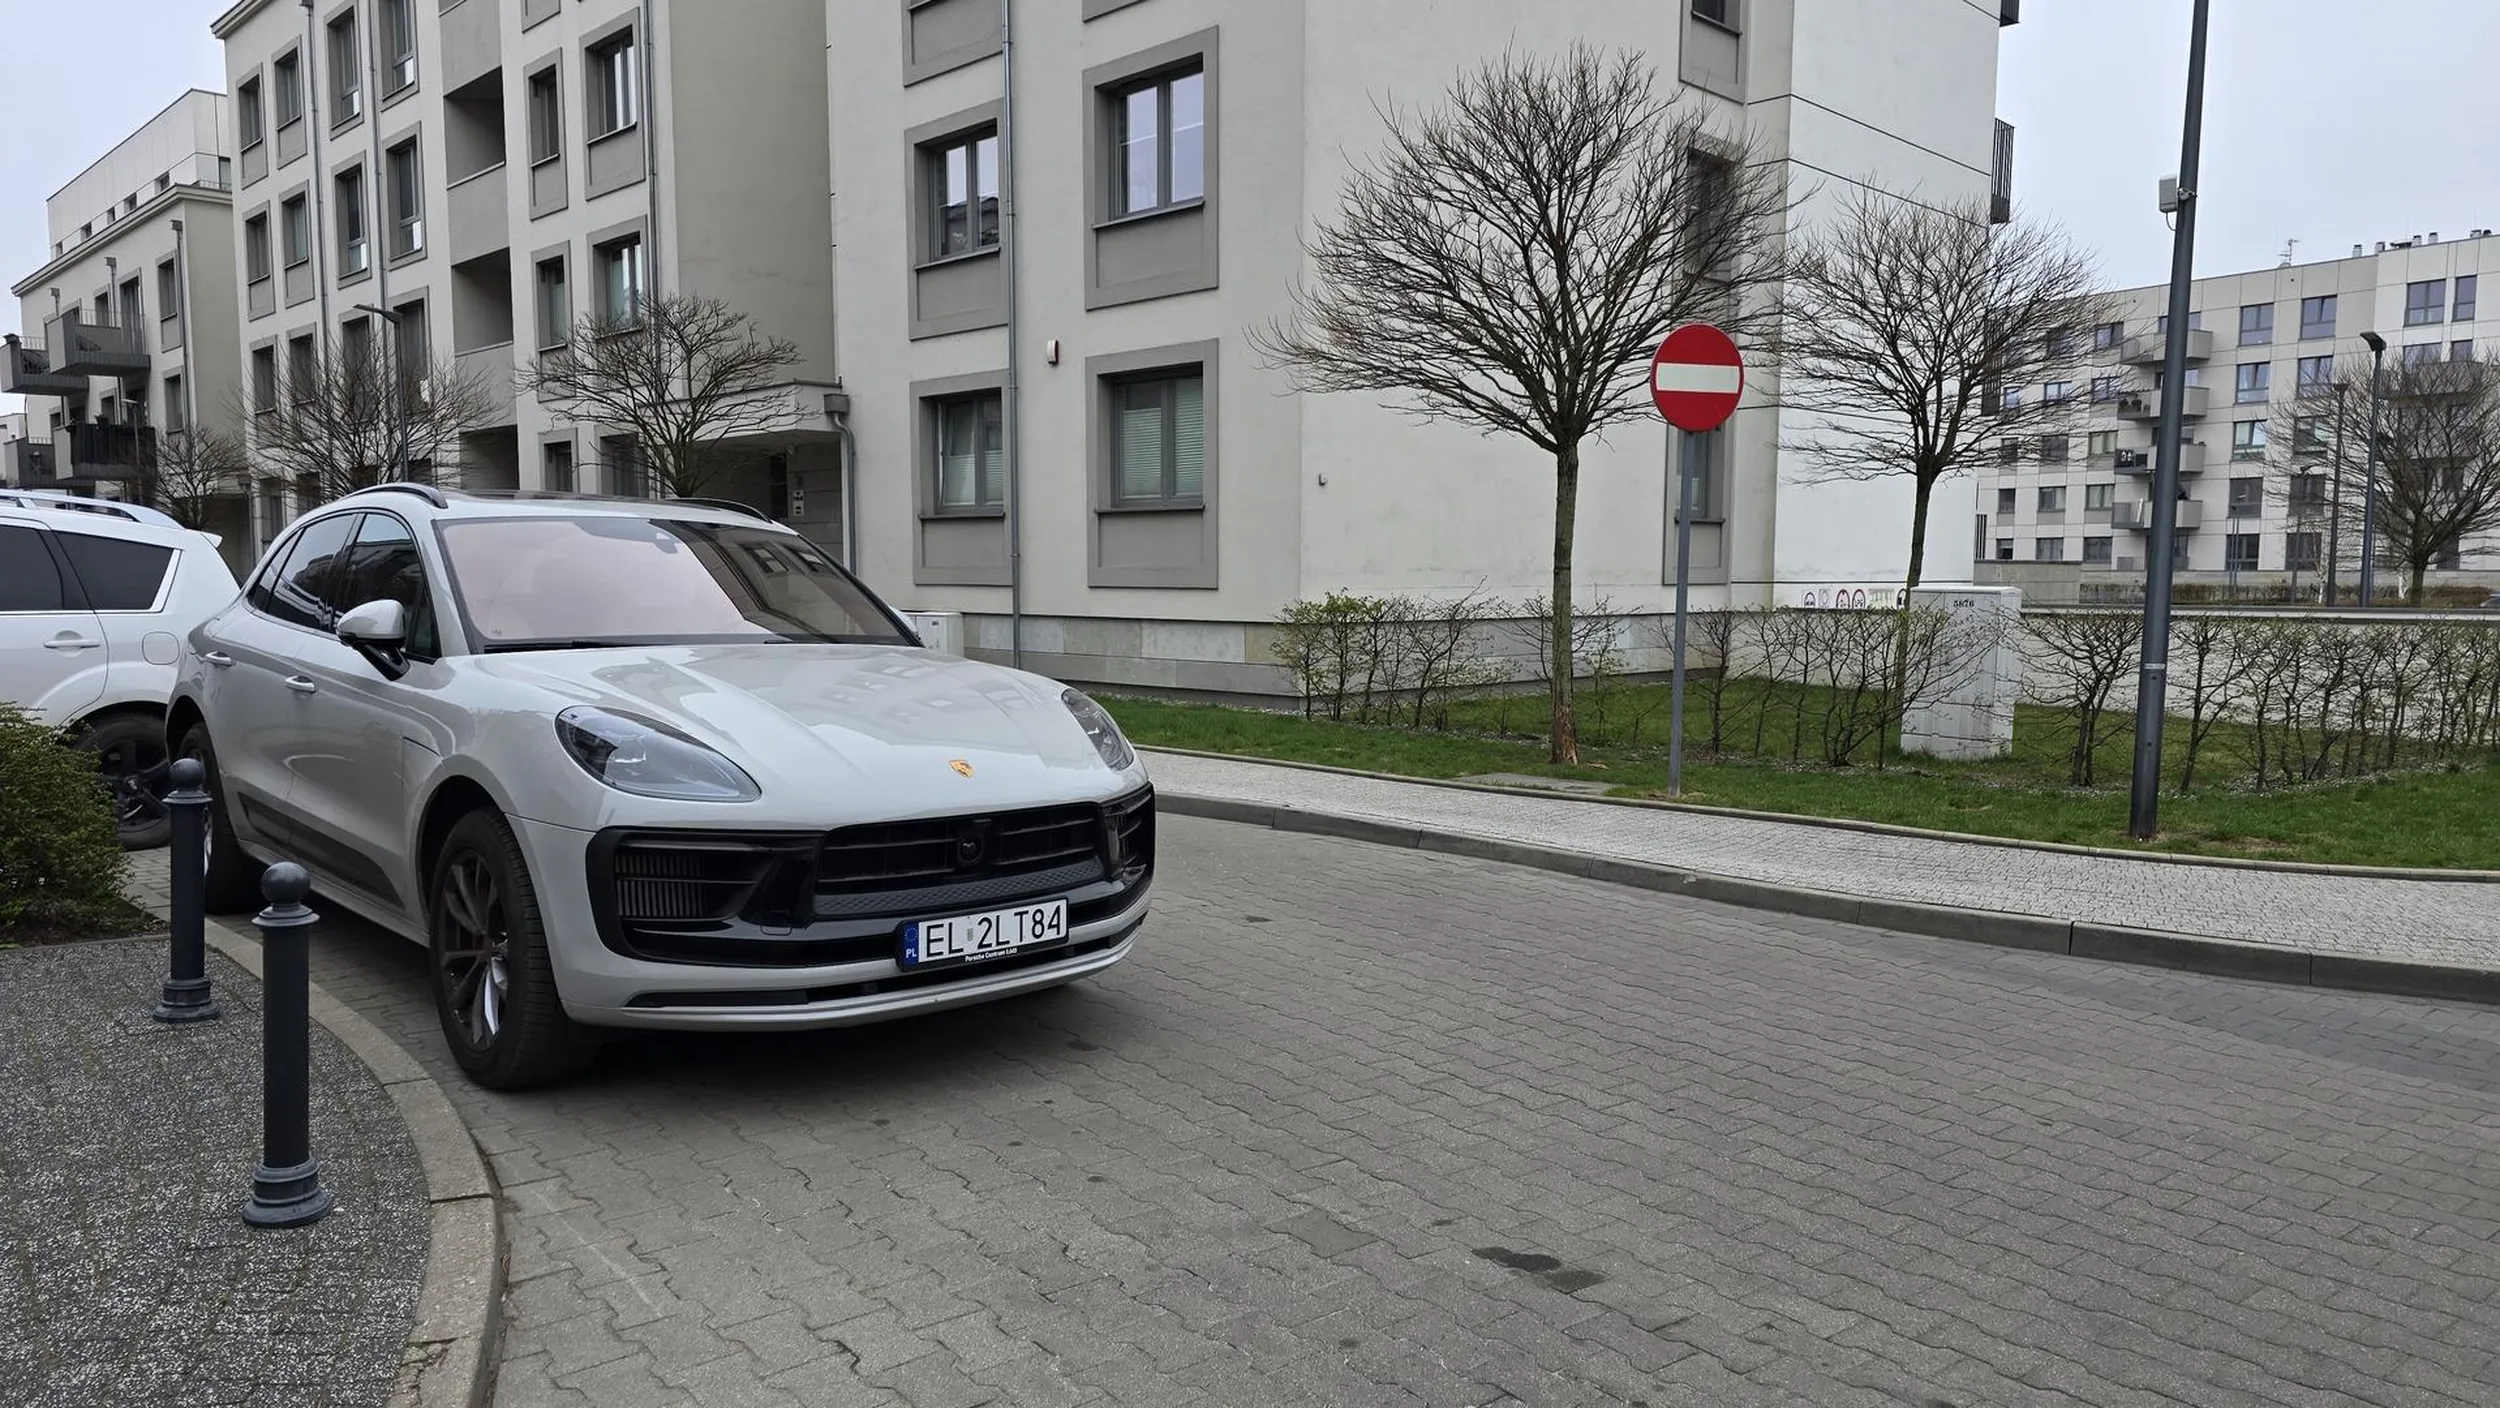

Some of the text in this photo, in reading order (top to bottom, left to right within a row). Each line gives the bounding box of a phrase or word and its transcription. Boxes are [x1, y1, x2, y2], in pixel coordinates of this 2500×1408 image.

[926, 905, 1061, 958] EL 2LT84
[905, 947, 917, 959] PL
[965, 953, 985, 962] Porsche
[985, 950, 1006, 959] Centrum
